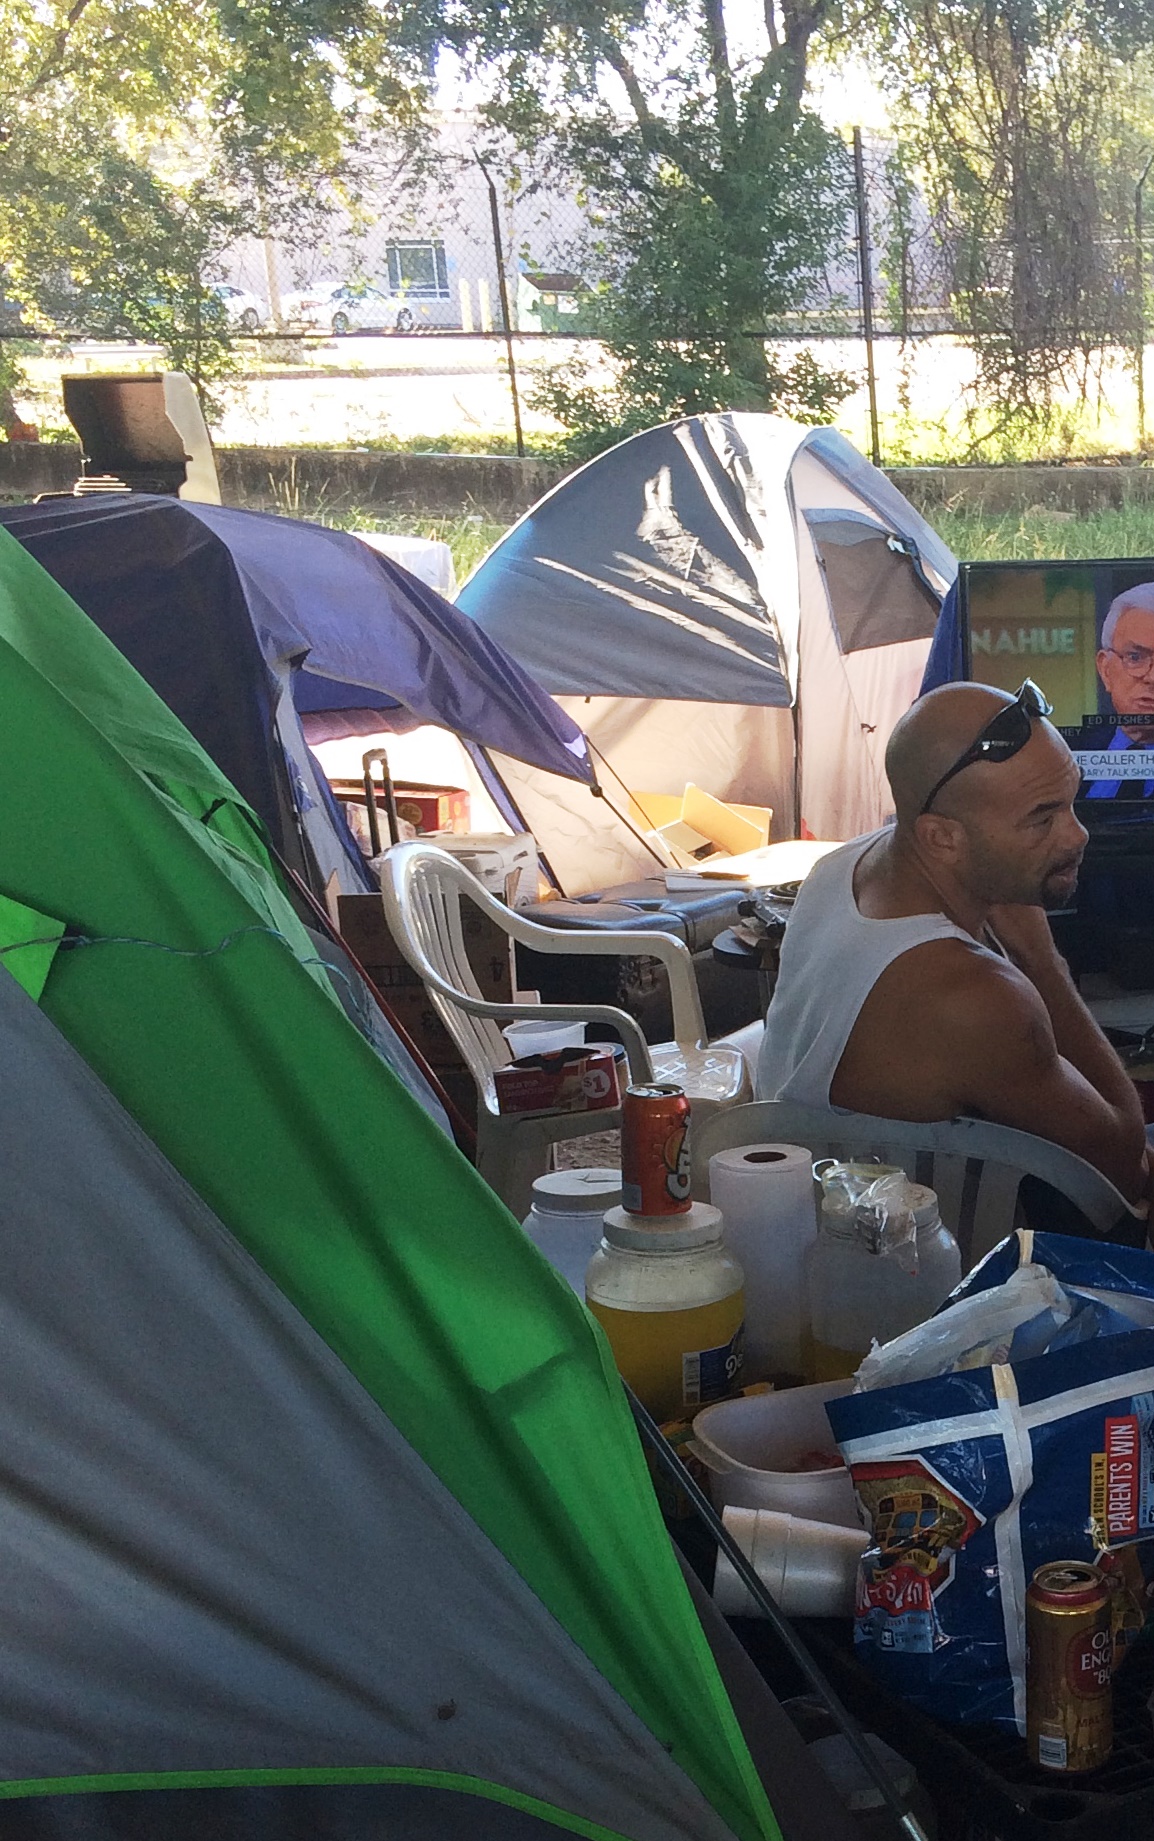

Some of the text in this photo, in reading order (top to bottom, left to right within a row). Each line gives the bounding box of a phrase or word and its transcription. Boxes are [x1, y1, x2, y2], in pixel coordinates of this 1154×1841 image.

[971, 627, 1075, 656] NAHUE
[1109, 715, 1151, 725] DISHES
[1090, 754, 1136, 765] CALLER
[1107, 768, 1129, 777] TALK
[583, 1075, 606, 1093] $1
[1108, 1424, 1136, 1532] PARENTS WIN
[1093, 1475, 1105, 1513] SCHOOL'S
